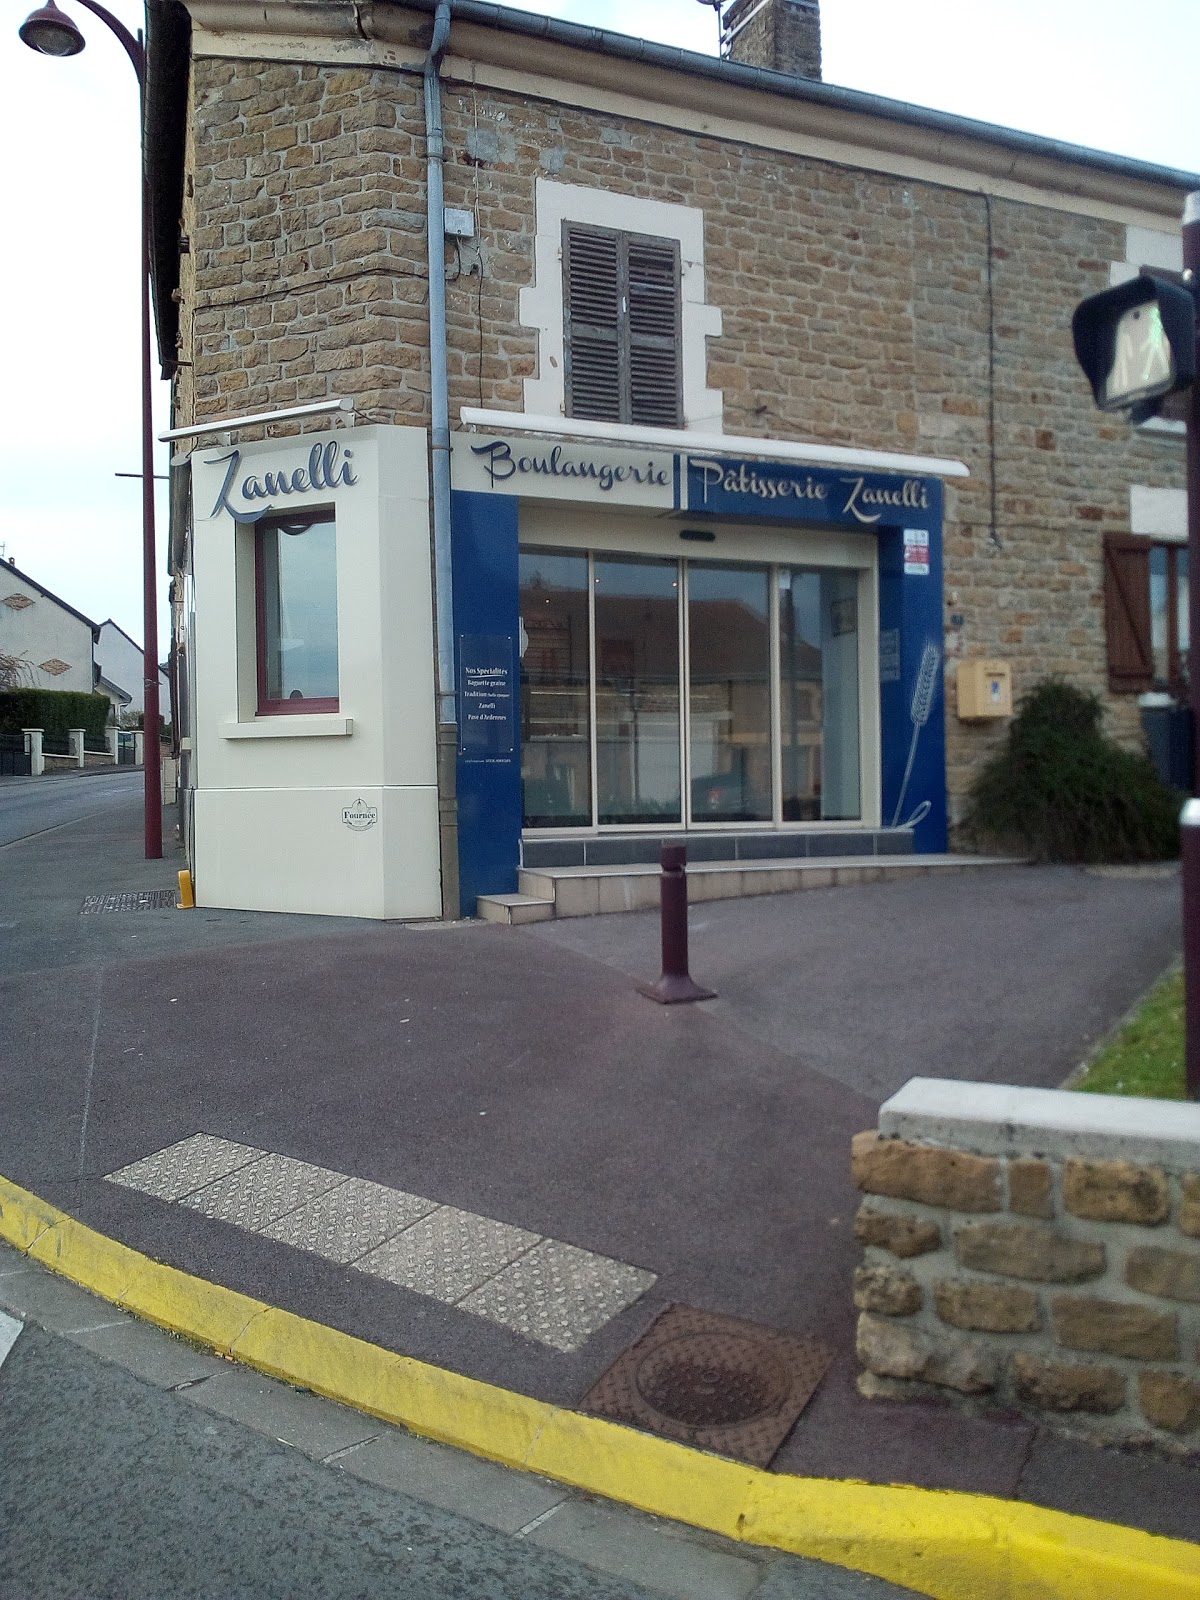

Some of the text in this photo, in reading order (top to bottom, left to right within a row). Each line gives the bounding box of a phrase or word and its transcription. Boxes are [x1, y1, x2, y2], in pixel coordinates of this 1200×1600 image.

[203, 440, 358, 523] Zanelli
[470, 440, 671, 491] Boulangerie
[690, 458, 928, 523] Pâtisserie Zanelli
